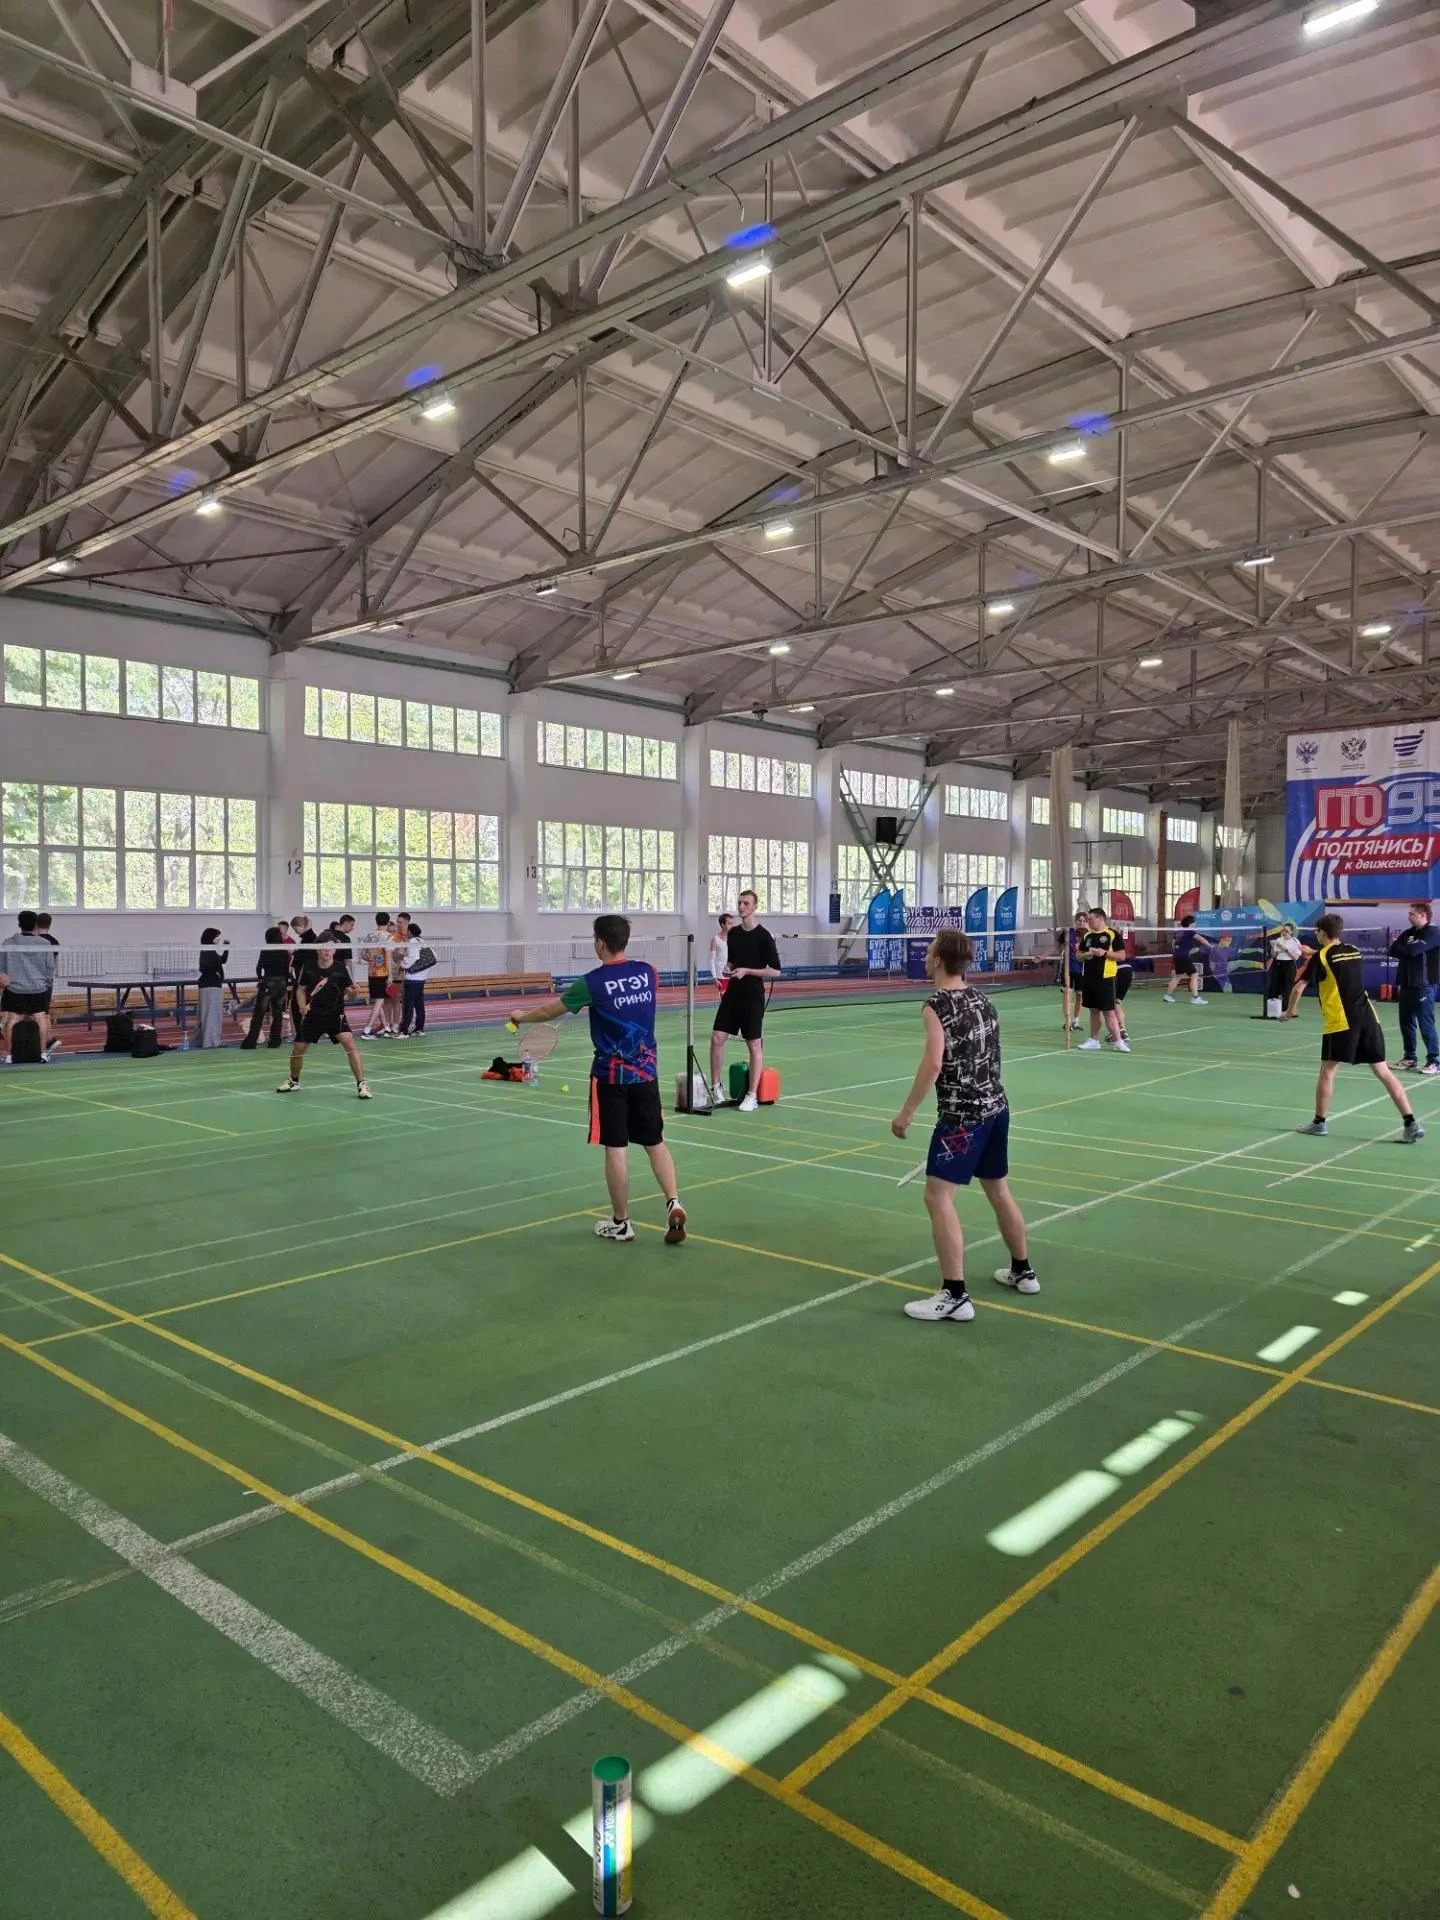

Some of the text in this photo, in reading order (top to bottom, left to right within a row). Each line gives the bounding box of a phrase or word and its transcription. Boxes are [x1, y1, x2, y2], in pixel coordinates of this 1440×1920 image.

[287, 860, 302, 875] 12
[526, 865, 537, 879] 13
[1345, 860, 1353, 870] к
[604, 972, 650, 996] РГЭУ
[613, 990, 653, 1010] (РИНХ)
